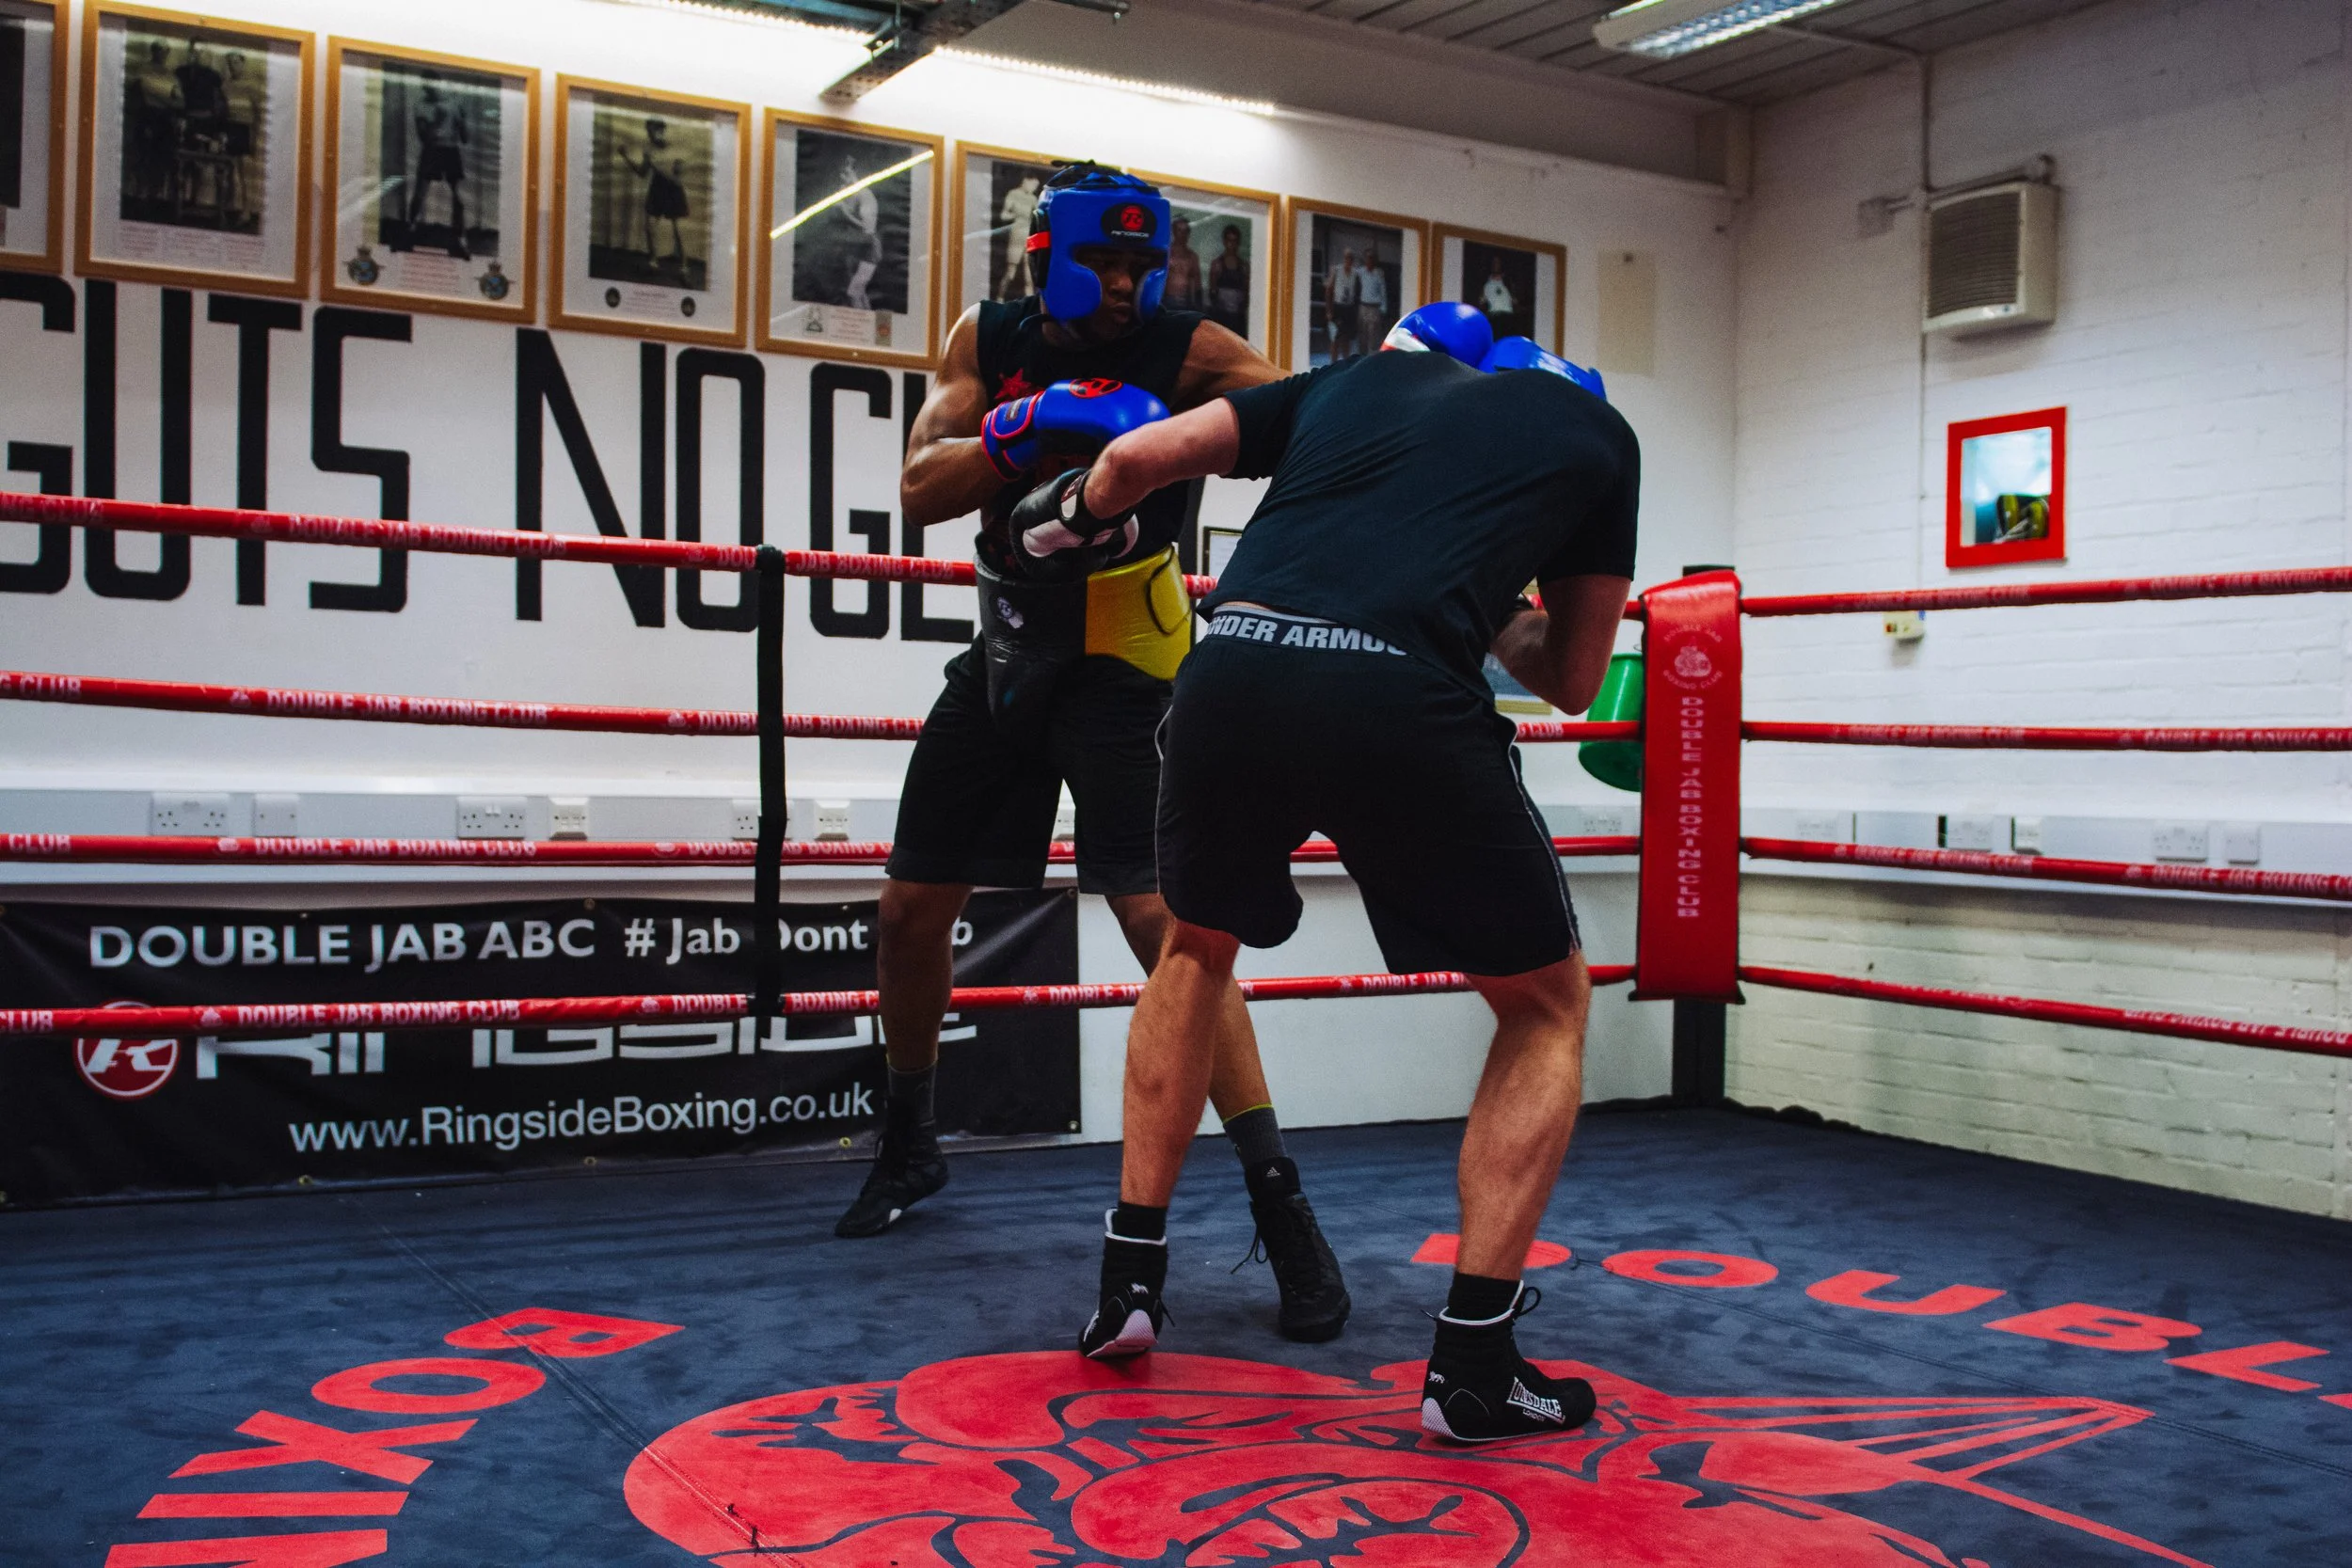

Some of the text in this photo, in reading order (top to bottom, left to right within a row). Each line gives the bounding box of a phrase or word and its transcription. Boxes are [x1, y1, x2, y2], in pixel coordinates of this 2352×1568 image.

[0, 271, 412, 613] GUTS
[516, 326, 765, 632] NO
[719, 546, 755, 569] DOU
[1280, 625, 1408, 656] ARMO
[20, 674, 81, 699] CLUB
[267, 690, 354, 714] DOUBLE
[699, 711, 758, 733] DOUBL
[9, 833, 72, 855] CLUB
[254, 837, 343, 856] DOUBLE
[89, 925, 351, 968] DOUBLE
[364, 922, 467, 974] JAB
[477, 919, 596, 961] ABC
[237, 999, 520, 1027] DOUBLE JAB BOXING CLUB
[671, 993, 747, 1016] DOUBLE
[789, 992, 860, 1014] BOXING
[196, 1012, 977, 1081] RINGSID
[288, 1082, 874, 1153] www.RingsideBoxing.co.uk
[1410, 1231, 2352, 1409] DOUBL
[1506, 1376, 1565, 1421] LONSDALE
